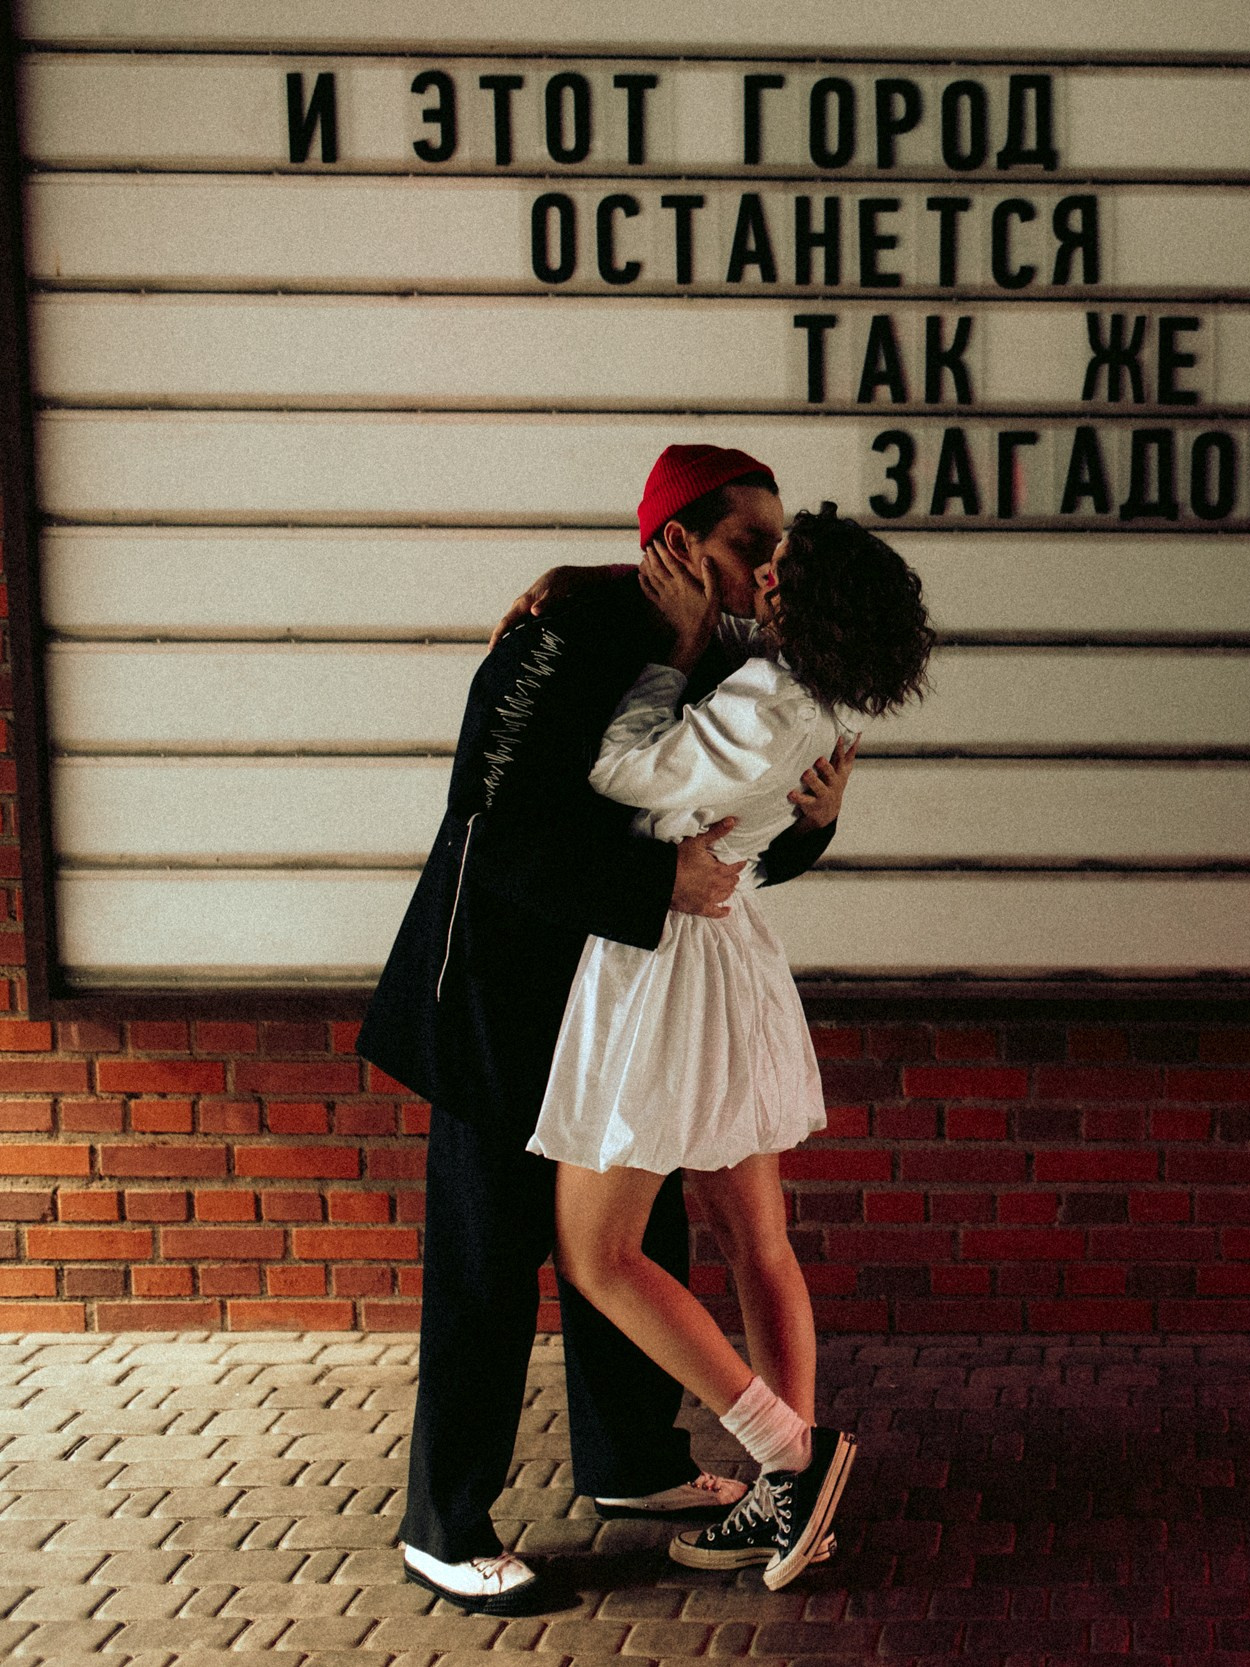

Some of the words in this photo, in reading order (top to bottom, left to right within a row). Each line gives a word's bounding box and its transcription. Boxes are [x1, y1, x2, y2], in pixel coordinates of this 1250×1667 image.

[287, 72, 338, 164] И
[411, 70, 658, 167] ЭТОТ
[742, 74, 1060, 172] ГОРОД
[531, 192, 1100, 290] ОСТАНЕТСЯ
[794, 313, 974, 405] ТАК
[1081, 312, 1201, 406] ЖЕ
